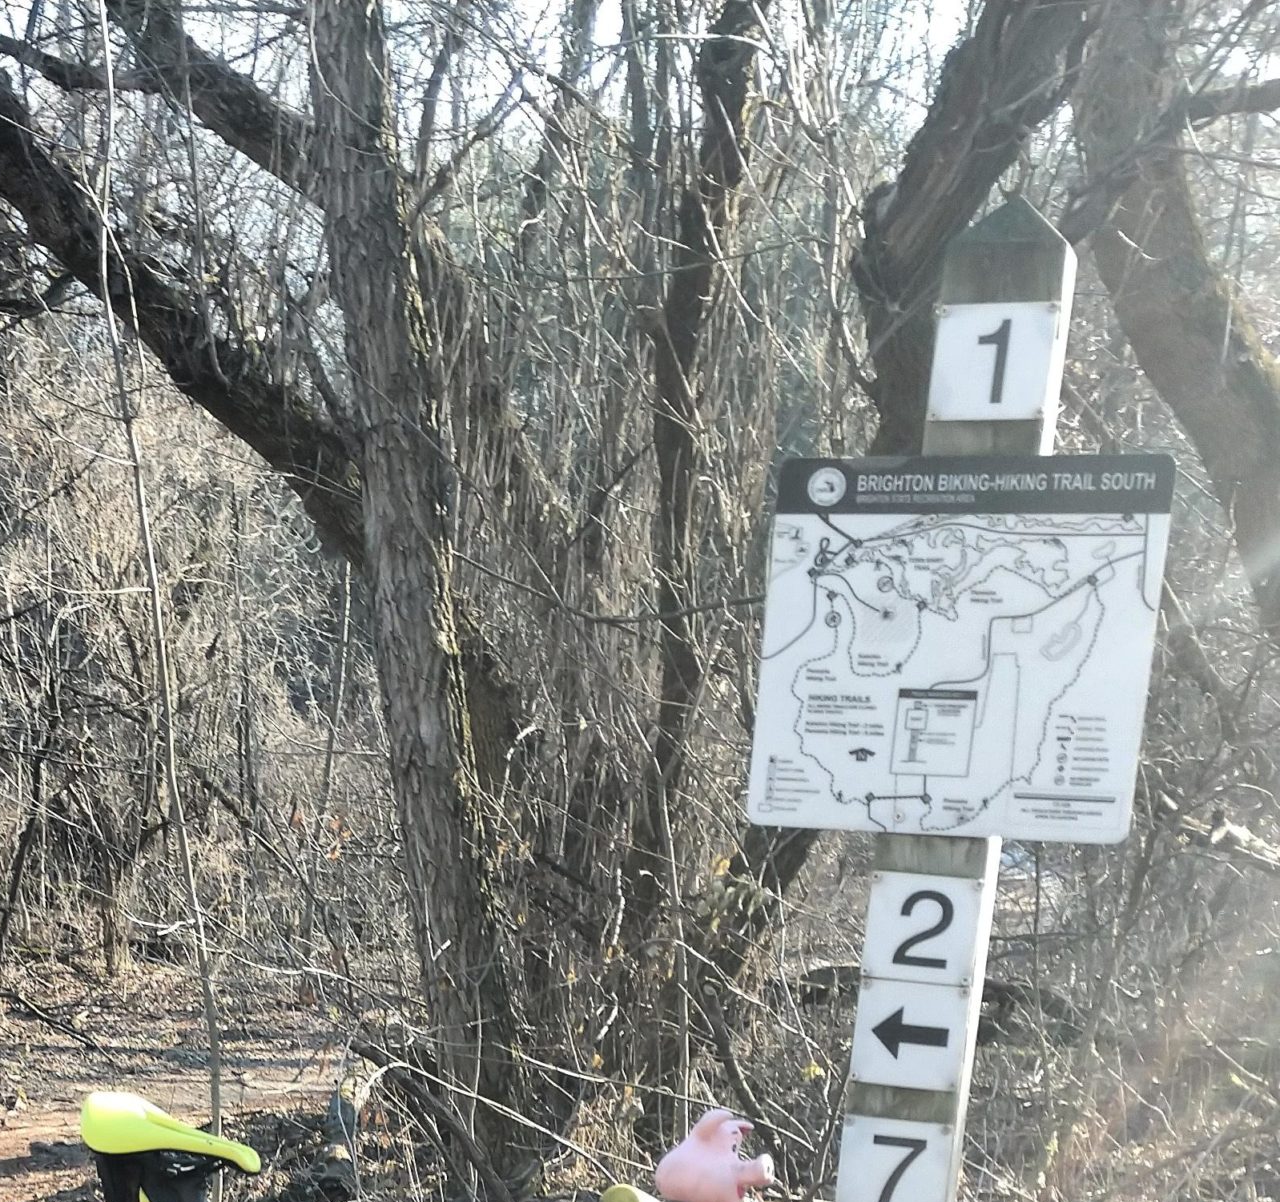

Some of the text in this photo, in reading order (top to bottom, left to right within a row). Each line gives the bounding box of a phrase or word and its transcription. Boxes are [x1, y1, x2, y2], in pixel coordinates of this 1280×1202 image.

[978, 319, 1012, 403] 1
[857, 472, 1156, 492] BRIGHTON BIKING-HIKING TRAIL SOUTH
[840, 695, 871, 703] TRAILS
[893, 891, 953, 968] 2
